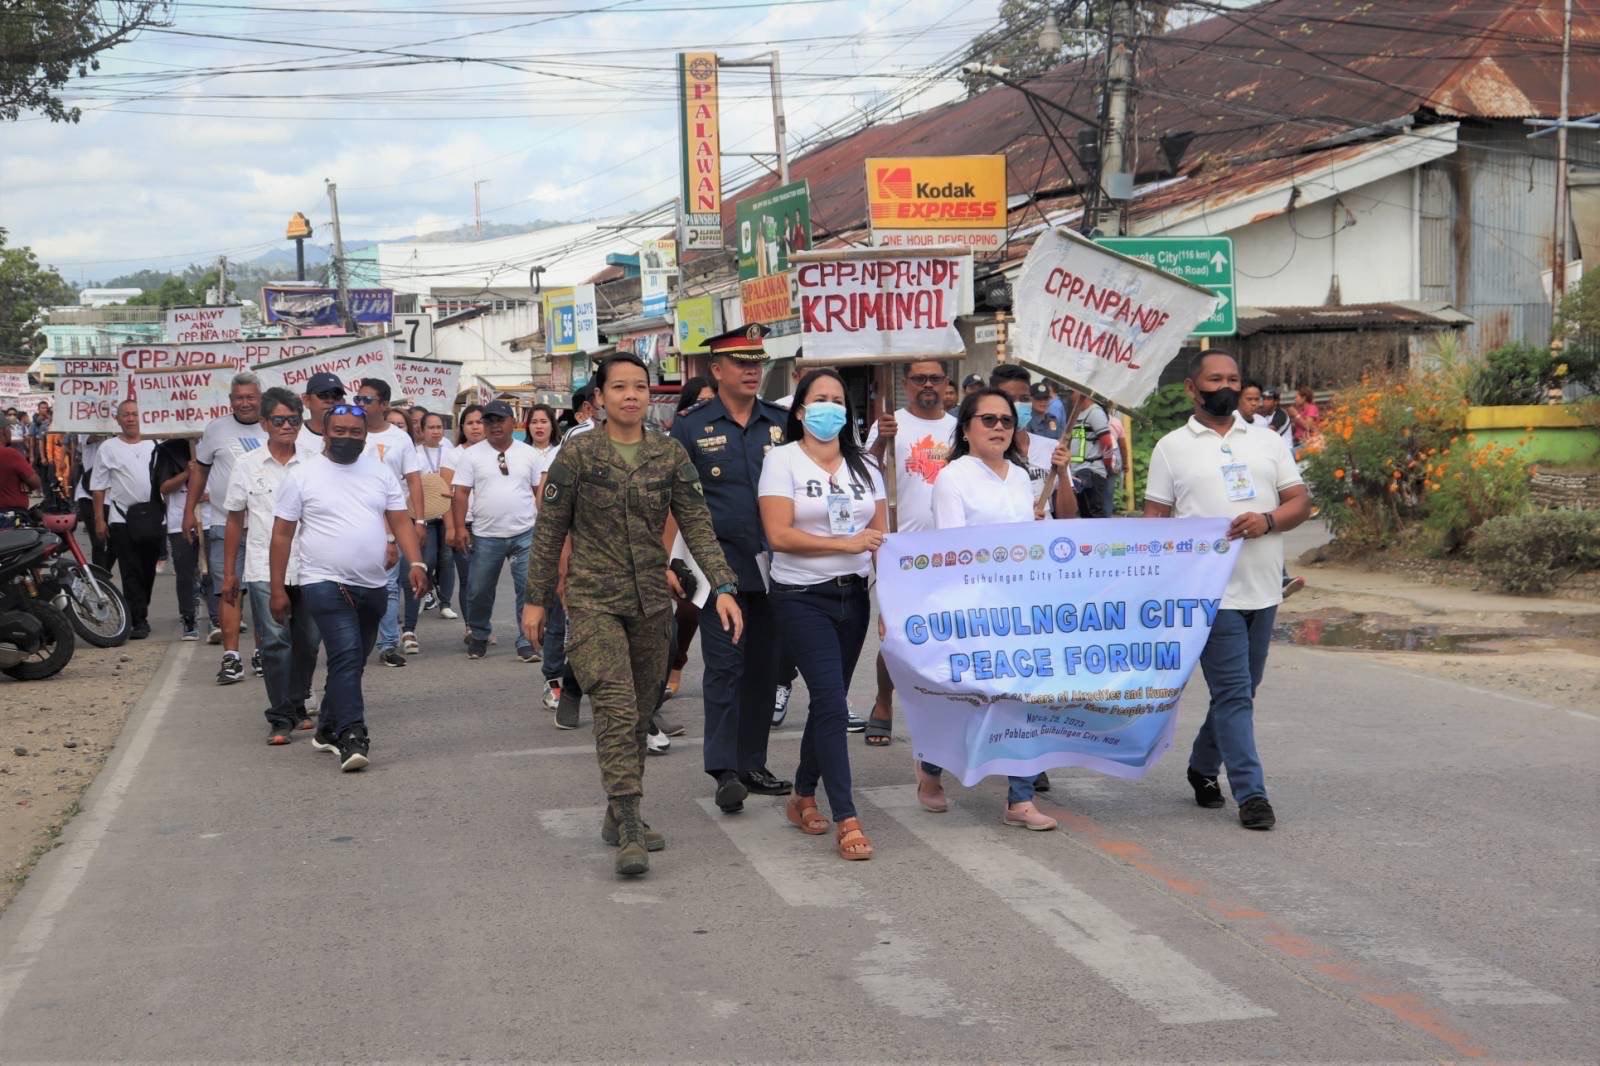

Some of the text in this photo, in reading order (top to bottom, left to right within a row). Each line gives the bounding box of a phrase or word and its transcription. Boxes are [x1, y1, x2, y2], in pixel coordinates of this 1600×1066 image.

[692, 82, 716, 211] PALAWAN
[916, 182, 976, 199] Kodak
[896, 201, 998, 219] EXPRESS
[882, 233, 998, 246] ONE HOUR DEVELOPING
[1157, 250, 1179, 266] City
[801, 288, 949, 333] KRIMINAL
[191, 322, 215, 334] ANG
[405, 319, 420, 353] 7
[355, 350, 384, 366] ANG
[140, 373, 212, 390] ISALIKWAY
[405, 375, 418, 385] SA
[423, 376, 443, 387] NPA
[170, 389, 198, 401] ANG
[431, 388, 447, 399] SA
[1030, 569, 1053, 583] City
[1059, 567, 1083, 580] Task
[904, 597, 1223, 646] GUIHULNGAN CITY
[949, 641, 1182, 683] PEACE FORUM
[1124, 686, 1144, 700] and
